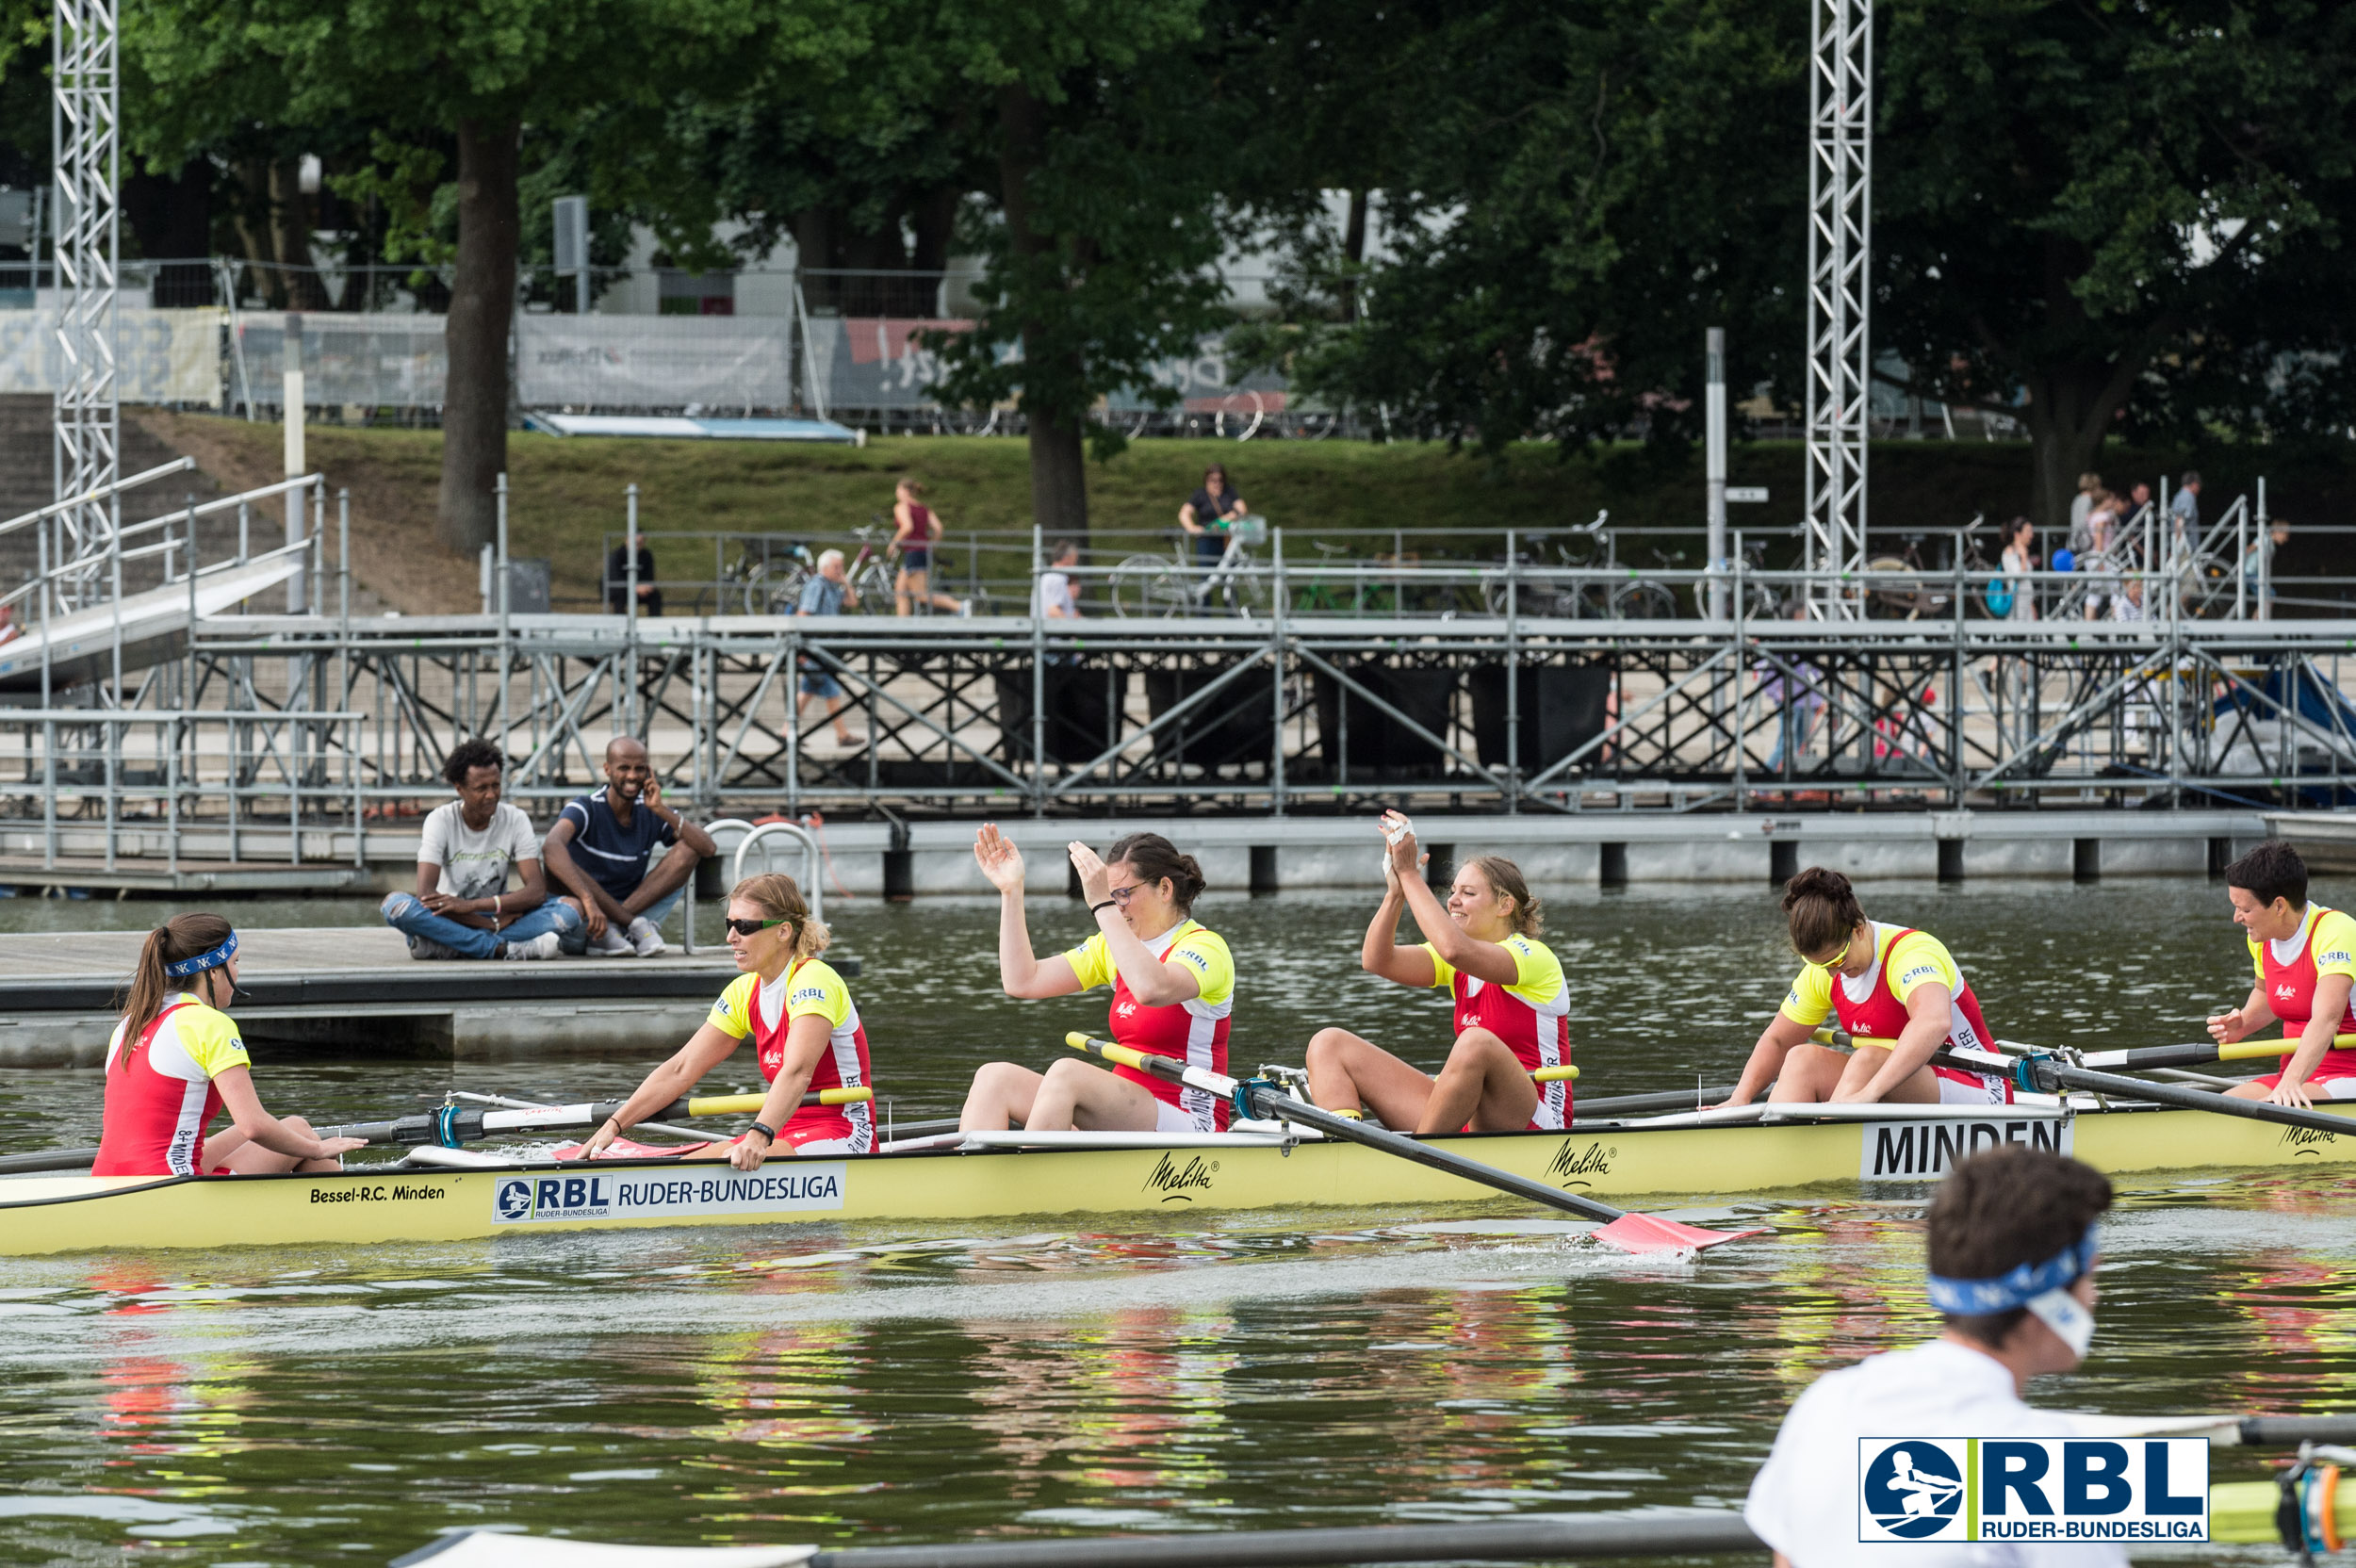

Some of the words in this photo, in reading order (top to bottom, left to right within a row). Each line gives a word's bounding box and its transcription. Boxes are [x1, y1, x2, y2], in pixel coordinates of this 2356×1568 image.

[196, 956, 212, 969] NK
[1186, 950, 1207, 972] RBL
[2329, 951, 2351, 962] RBL
[175, 963, 190, 973] NK
[1913, 966, 1937, 976] RBL
[799, 988, 826, 1000] RBL
[170, 1143, 190, 1176] MINDE
[310, 1185, 387, 1203] Bessel-R.C.
[392, 1184, 445, 1200] Minden
[536, 1178, 609, 1209] RBL
[618, 1176, 838, 1206] RUDER-BUNDESLIGA
[535, 1208, 608, 1217] RUDER-BUNDESLIGA
